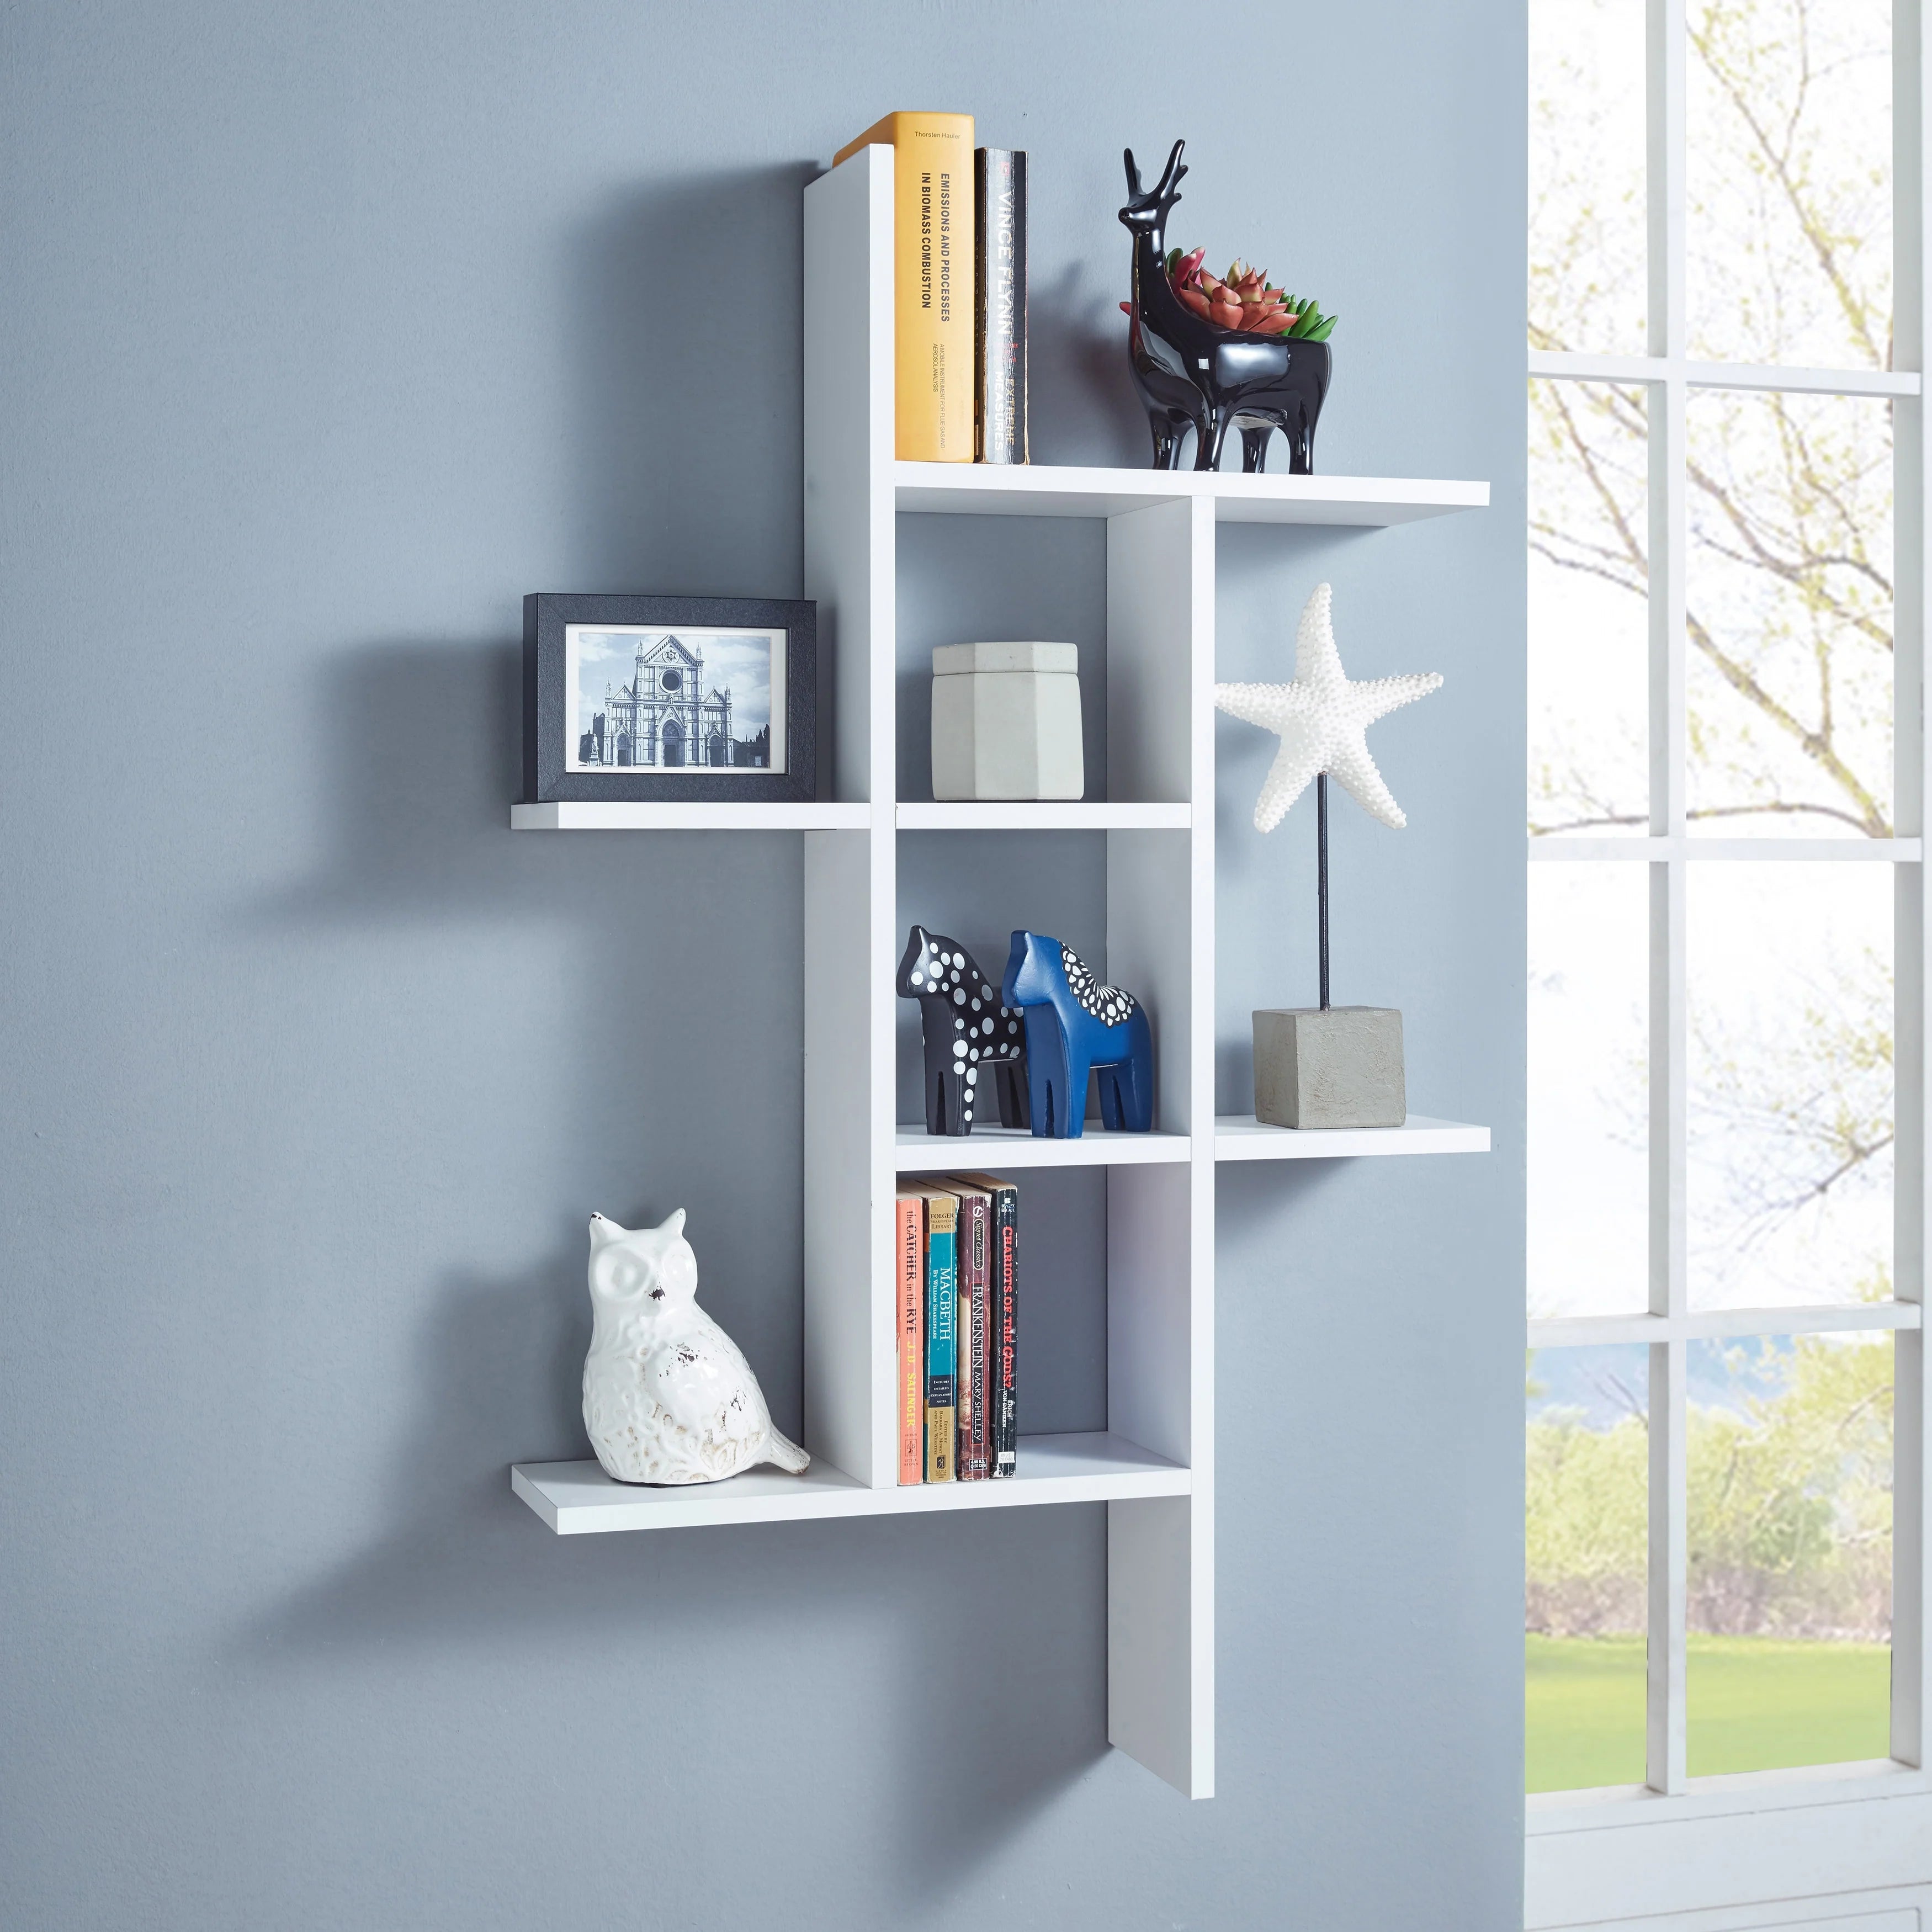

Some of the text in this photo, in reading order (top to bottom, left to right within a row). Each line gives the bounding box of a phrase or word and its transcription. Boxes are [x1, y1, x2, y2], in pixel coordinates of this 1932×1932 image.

[921, 172, 931, 308] IN BIOMASS COMBUSTION
[941, 173, 950, 322] EMISSIONS AND PROCESSES
[997, 189, 1014, 259] VINCE
[997, 266, 1014, 335] FLYNN
[994, 371, 1004, 451] MEASURES
[1006, 378, 1016, 445] EXTREME
[906, 1211, 916, 1223] the
[906, 1224, 917, 1281] CATCHER
[933, 1269, 938, 1278] BY
[906, 1294, 916, 1307] the
[906, 1308, 917, 1334] RYE
[940, 1267, 951, 1341] MACBETH
[973, 1286, 983, 1369] FRANKENSTEIN
[1002, 1225, 1013, 1388] CHARIOTS OF THE GODS?
[907, 1341, 916, 1351] J.
[906, 1372, 916, 1429] SALINGER
